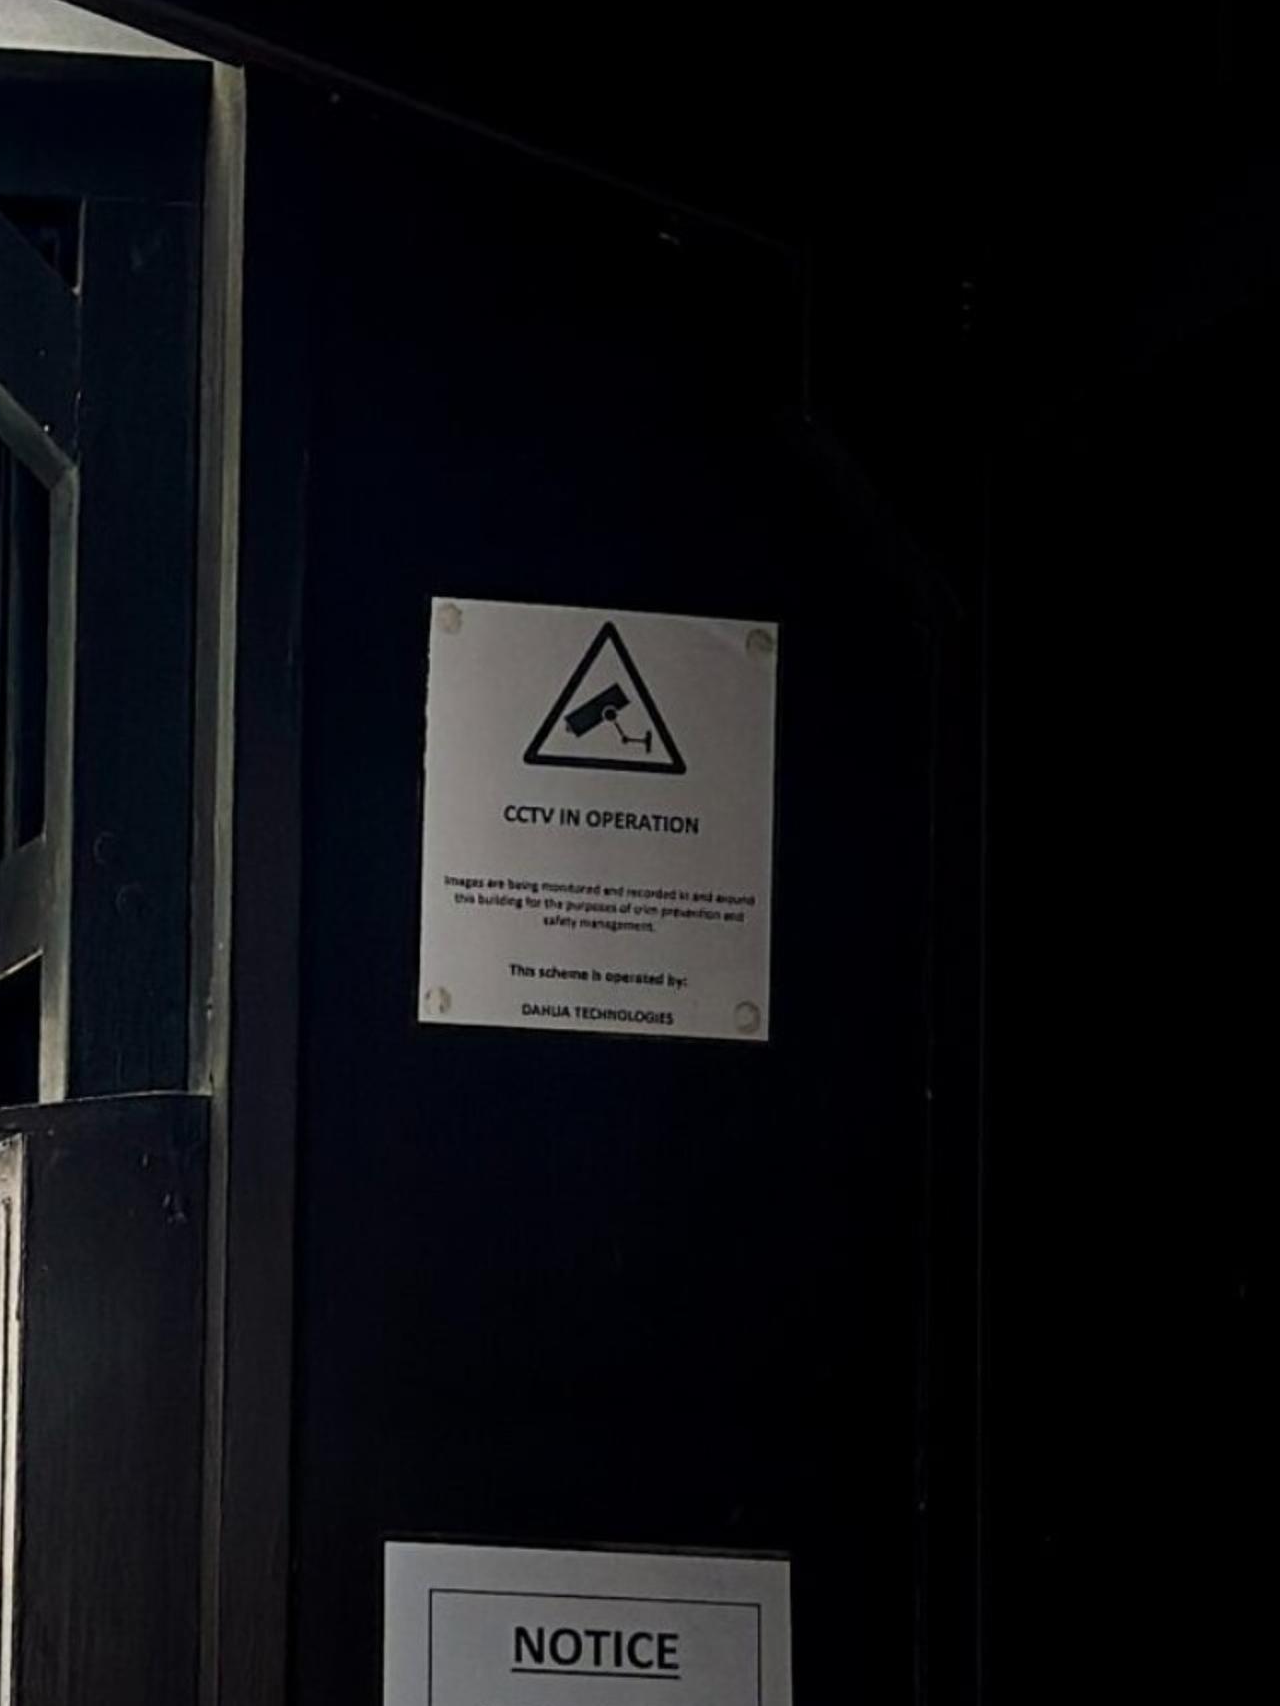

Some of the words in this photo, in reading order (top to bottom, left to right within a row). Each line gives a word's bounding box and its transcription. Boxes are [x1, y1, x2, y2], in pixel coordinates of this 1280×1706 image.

[504, 805, 554, 824] CCTV
[560, 809, 580, 826] IN
[586, 810, 699, 834] OPERATION
[455, 894, 475, 903] this
[478, 895, 522, 908] building
[525, 897, 541, 907] for
[544, 899, 562, 909] the
[619, 903, 631, 913] of
[511, 964, 535, 977] This
[539, 967, 588, 980] scheme
[606, 972, 664, 985] operated
[575, 1007, 674, 1025] TECHNOLOGIES
[513, 1627, 680, 1670] NOTICE
